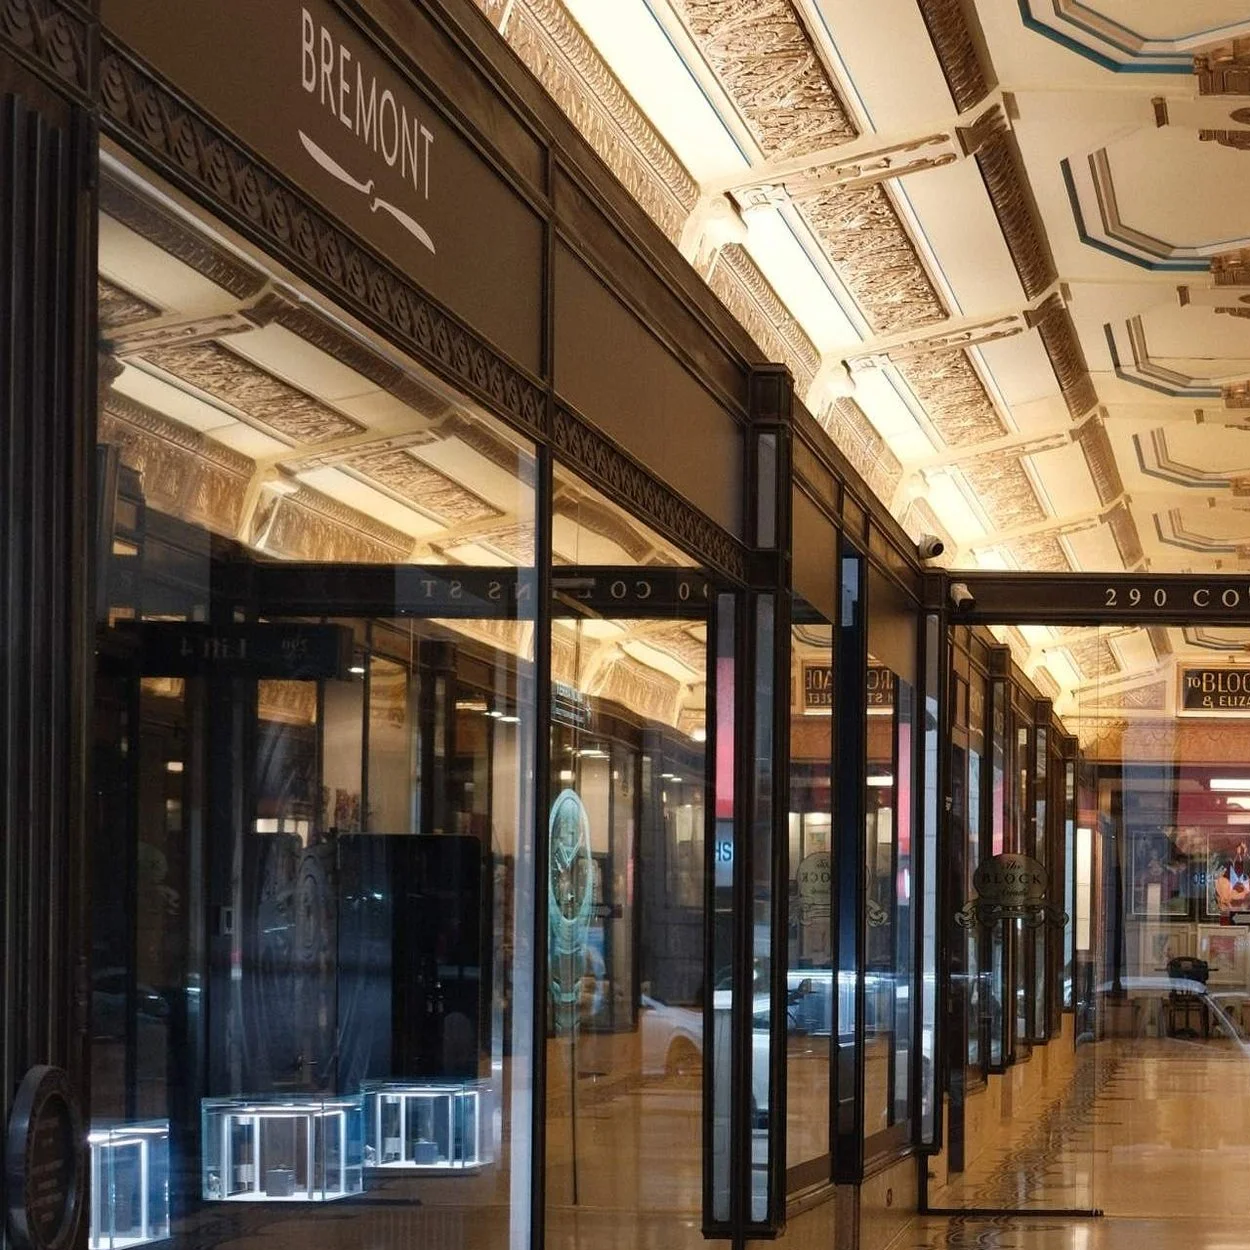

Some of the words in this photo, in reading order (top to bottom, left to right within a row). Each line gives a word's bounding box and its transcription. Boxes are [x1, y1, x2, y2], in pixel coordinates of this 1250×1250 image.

[301, 7, 434, 201] BREMONT
[1105, 588, 1168, 607] 290
[1186, 676, 1202, 688] TO
[1202, 696, 1214, 709] &
[981, 873, 1041, 884] BLOCK
